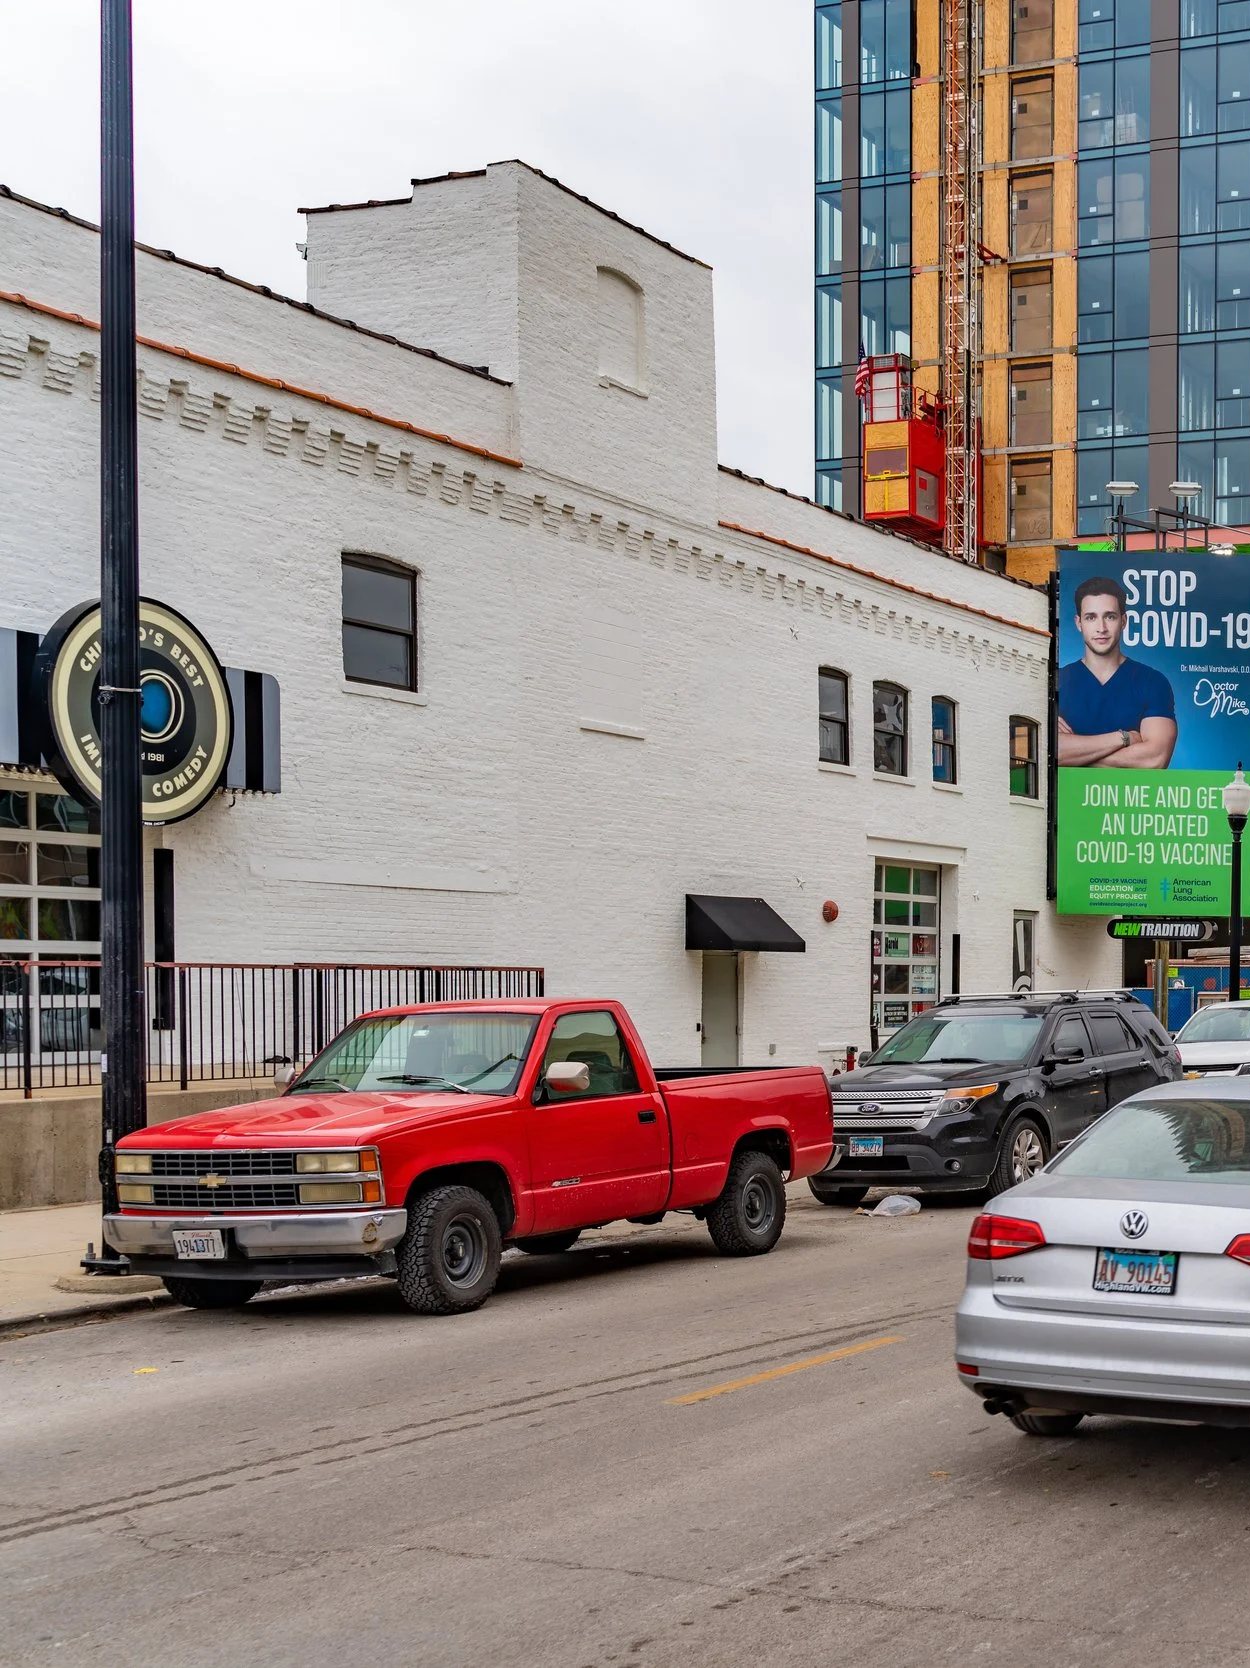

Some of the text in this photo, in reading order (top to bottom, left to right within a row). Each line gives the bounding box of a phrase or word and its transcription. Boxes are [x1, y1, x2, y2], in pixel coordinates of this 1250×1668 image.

[1123, 569, 1197, 606] STOP
[169, 643, 204, 687] BEST
[1188, 664, 1209, 672] Mikhail
[1209, 665, 1240, 674] Varshavski,
[1193, 678, 1240, 706] Doctor
[1210, 690, 1250, 718] Mike
[147, 752, 165, 762] 1981
[152, 745, 207, 797] COMEDY
[1081, 784, 1119, 807] JOIN
[1124, 785, 1150, 808] ME
[1155, 786, 1191, 808] AND
[1101, 813, 1208, 837] AN UPDATED
[1076, 841, 1232, 866] COVID-19 VACCINE
[1172, 878, 1211, 886] American
[1173, 886, 1193, 895] Lung
[1172, 894, 1218, 902] Association
[1099, 1258, 1172, 1285] AV 90145
[1094, 1280, 1171, 1294] HighlandVW.com
